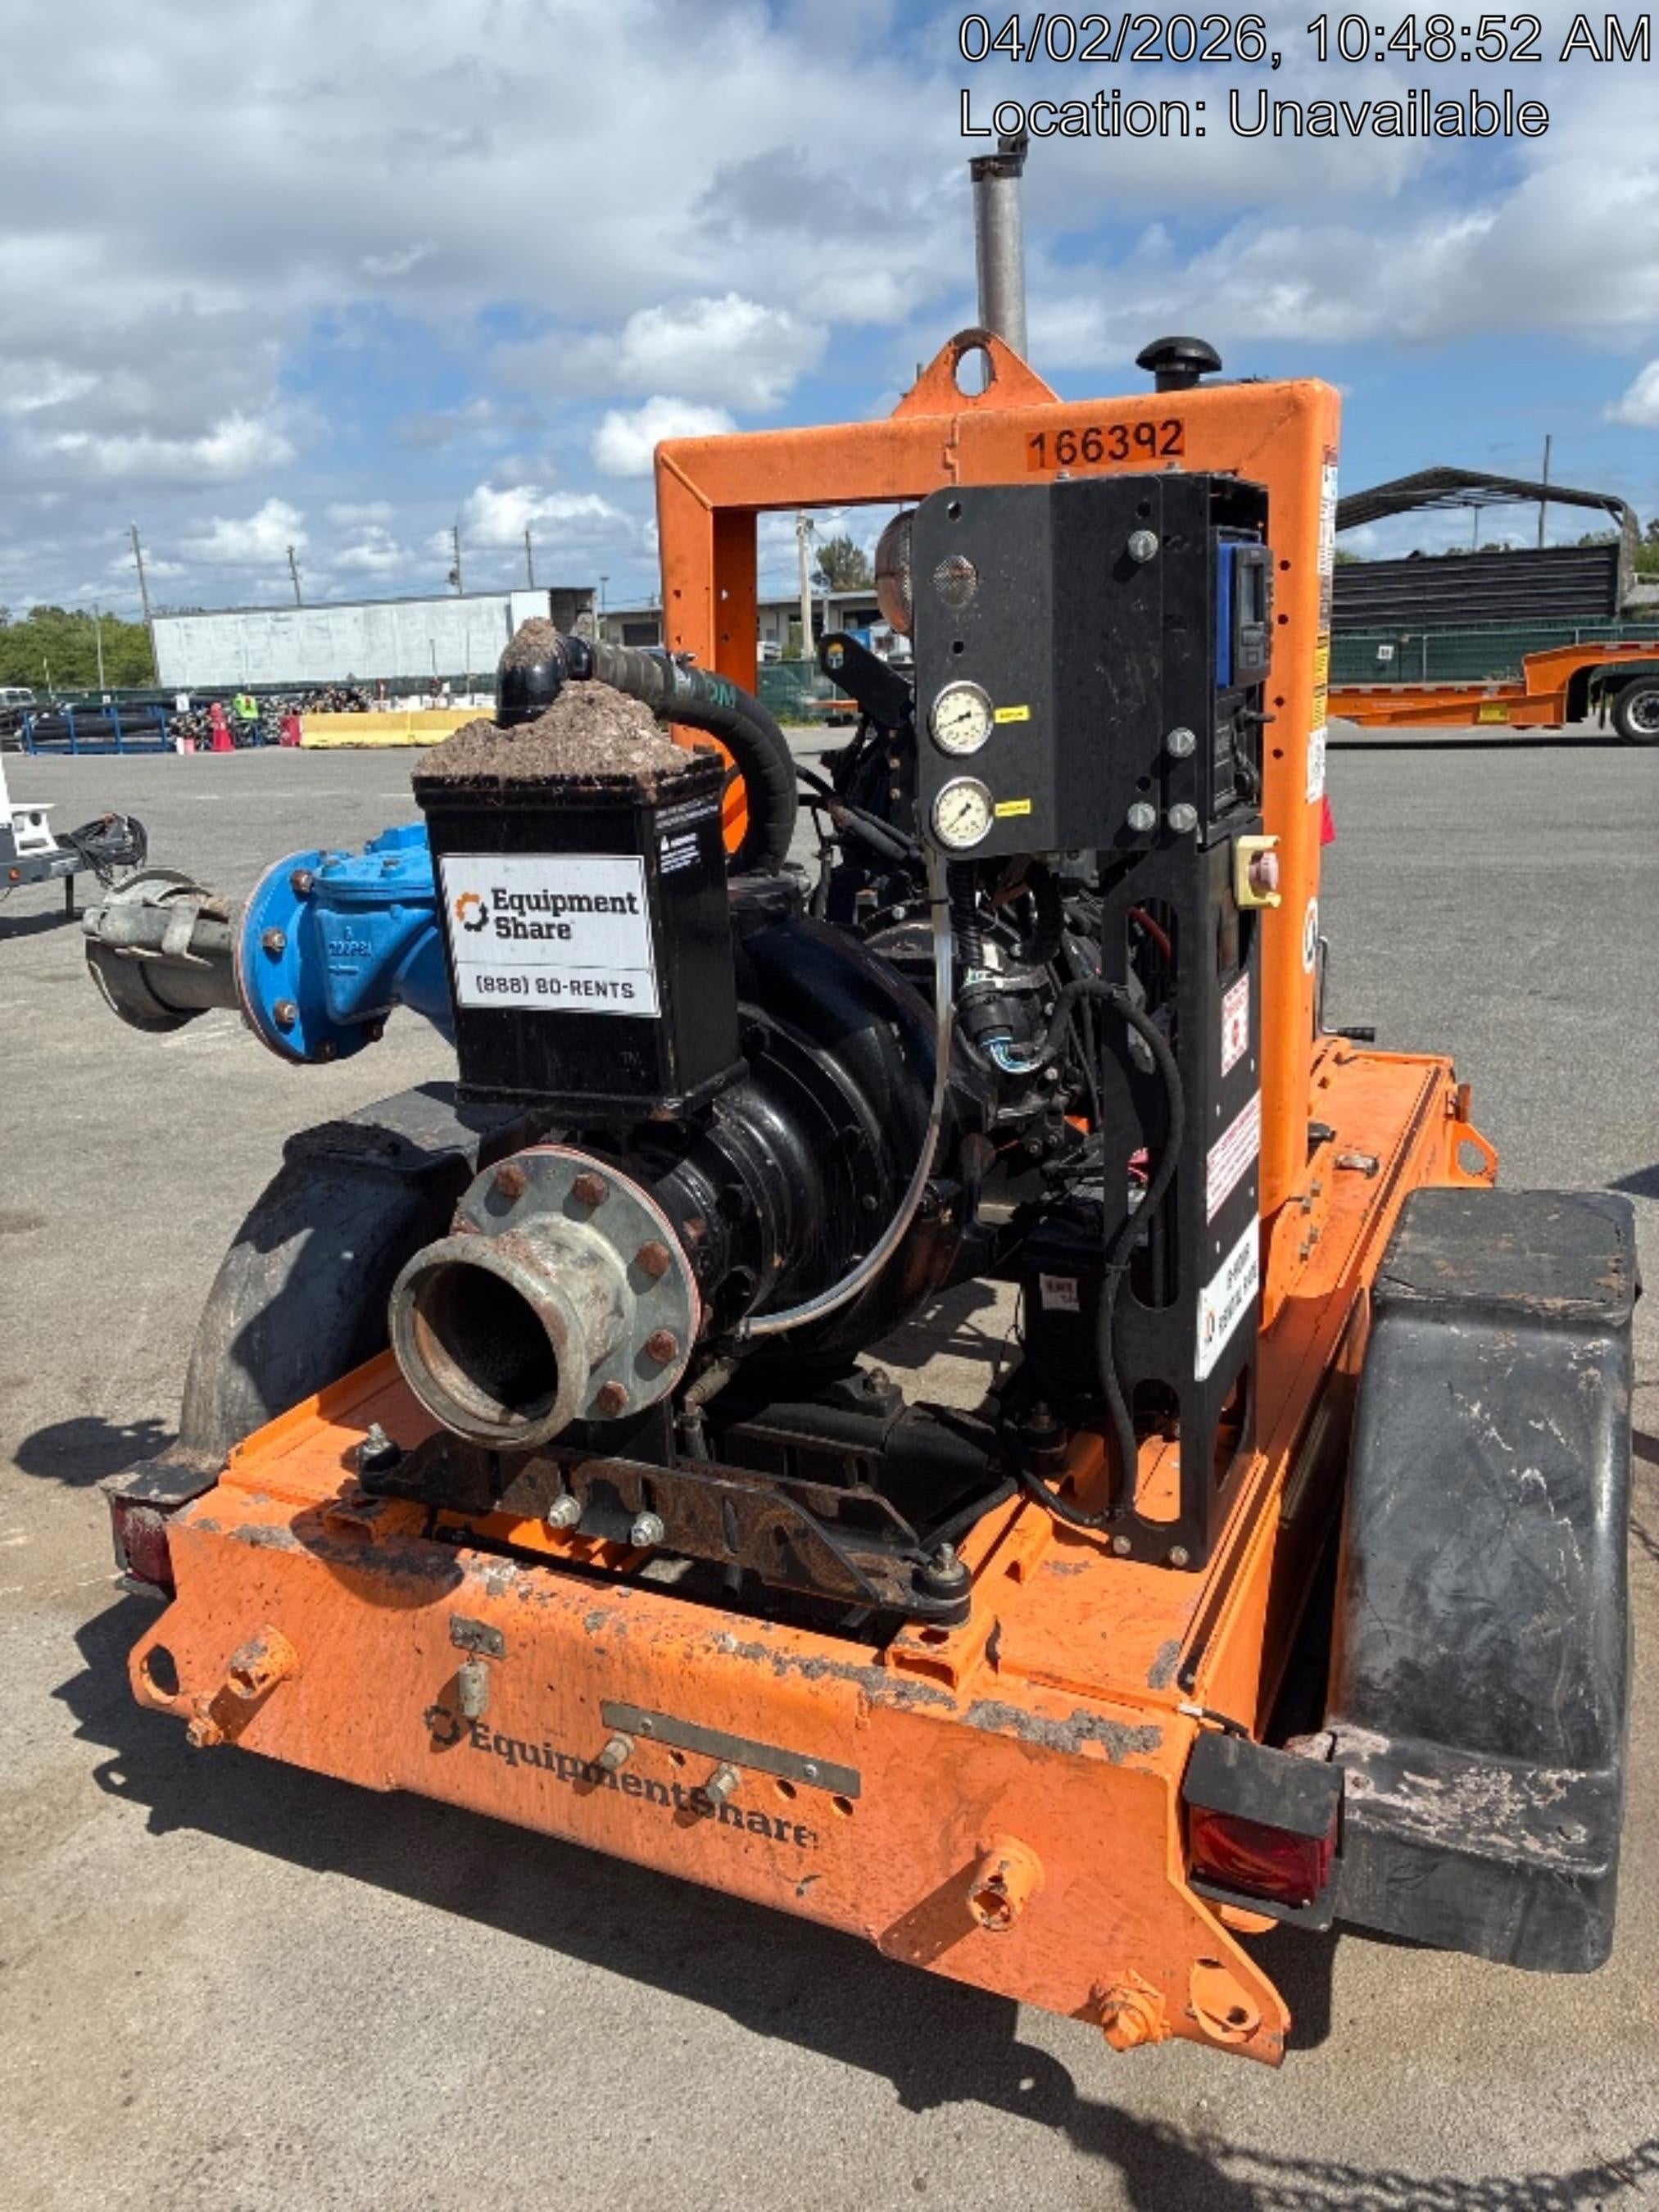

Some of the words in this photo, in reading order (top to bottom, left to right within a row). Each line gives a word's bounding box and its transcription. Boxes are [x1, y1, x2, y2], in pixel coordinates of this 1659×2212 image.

[1029, 419, 1183, 468] 166392
[491, 887, 640, 918] Equipment
[495, 916, 572, 941] Share
[476, 975, 529, 995] (888)
[469, 1720, 820, 1849] EquipmentShare
